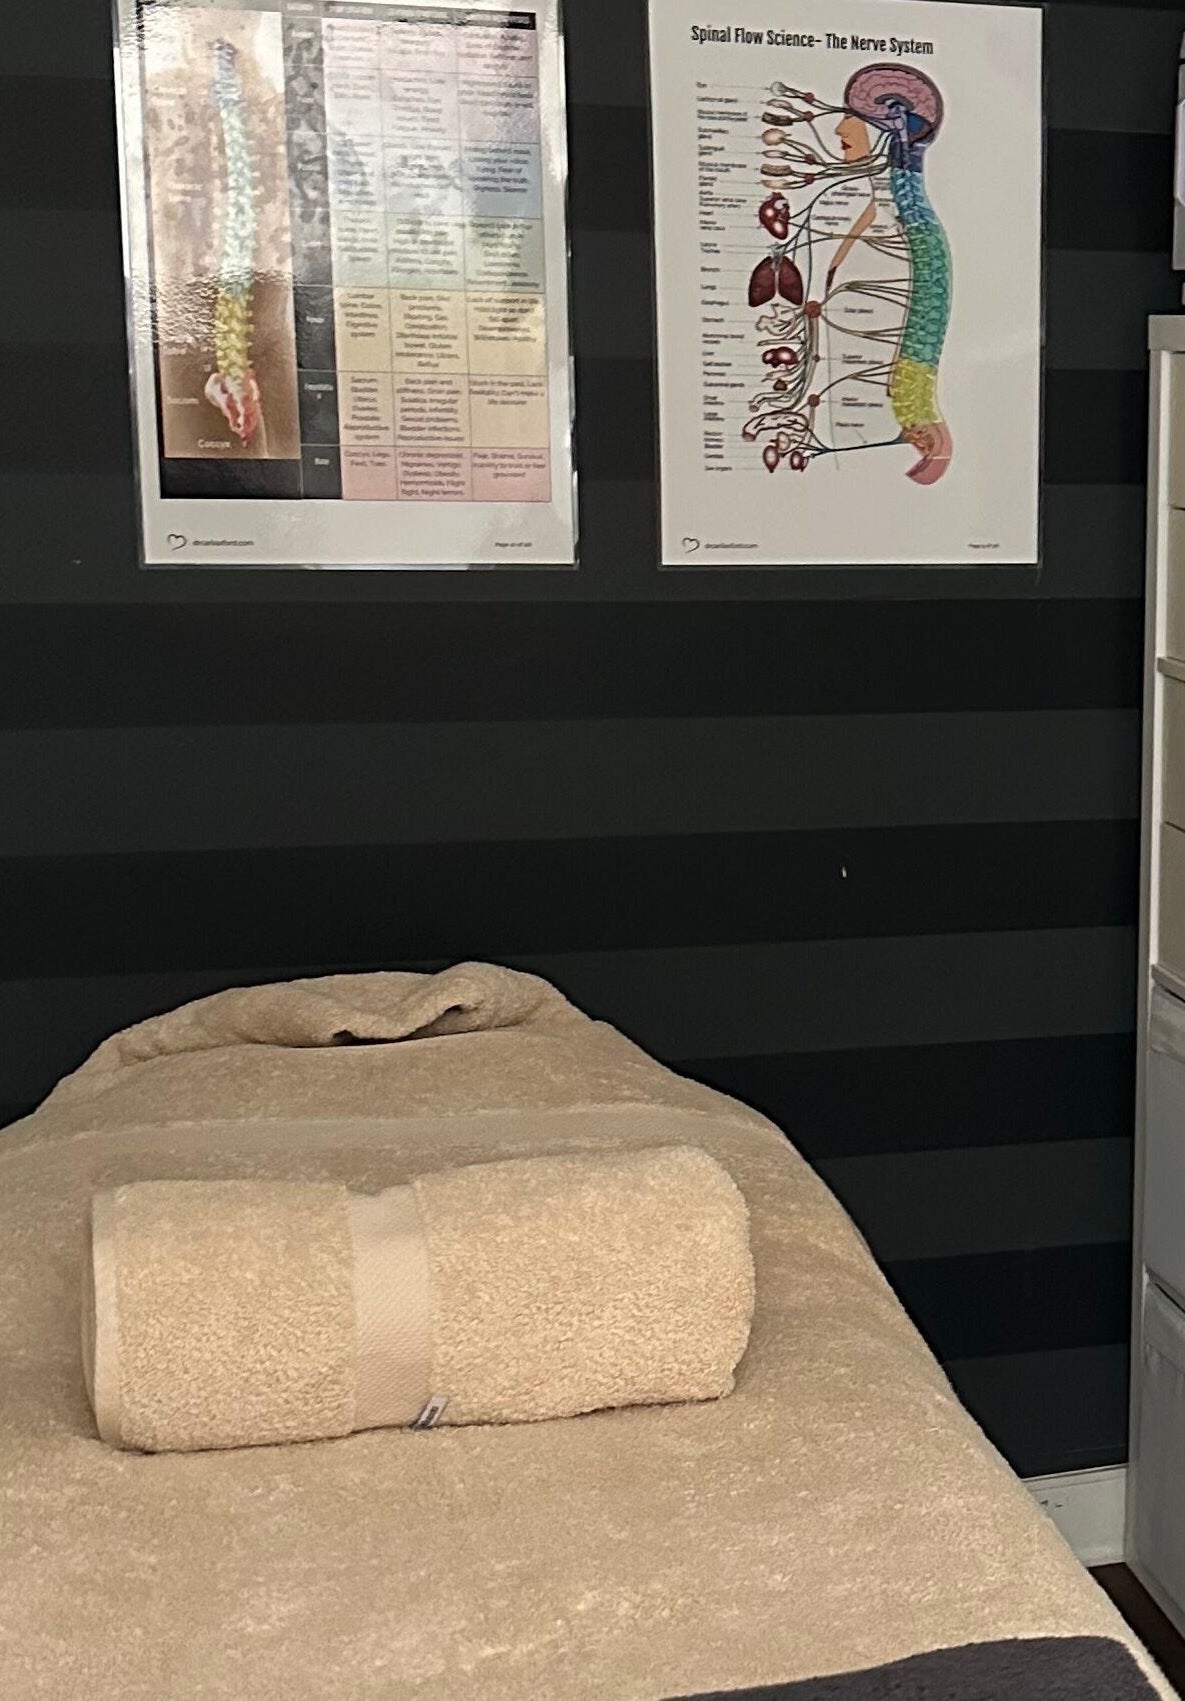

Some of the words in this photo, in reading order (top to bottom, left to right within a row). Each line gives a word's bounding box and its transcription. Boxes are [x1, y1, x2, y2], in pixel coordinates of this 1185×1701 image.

[691, 25, 731, 44] Spinal
[735, 27, 763, 44] Flow
[767, 29, 822, 47] Science-
[825, 33, 848, 50] The
[851, 35, 887, 52] Nerve
[889, 37, 934, 56] System
